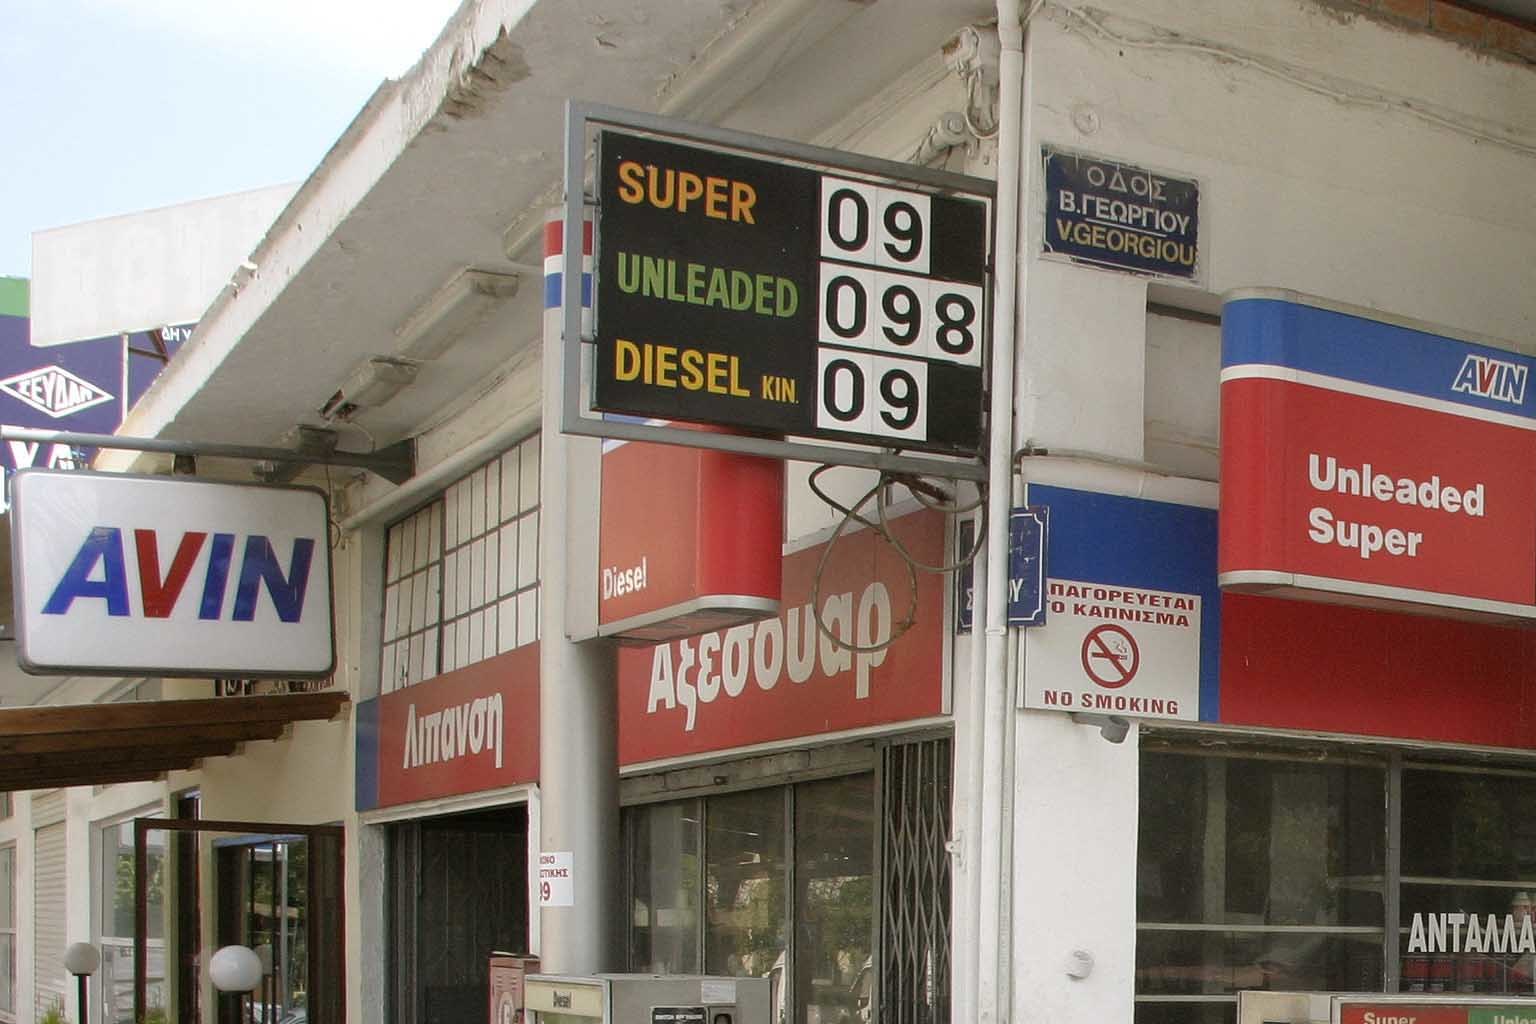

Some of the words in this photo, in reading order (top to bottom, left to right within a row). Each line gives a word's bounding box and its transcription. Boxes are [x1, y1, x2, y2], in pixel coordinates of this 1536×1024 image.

[618, 160, 758, 225] SUPER
[1087, 166, 1167, 200] ΟΔΟΣ
[827, 188, 923, 262] 09
[1059, 190, 1190, 235] Β.ΓΕΩΡΓΙΟΥ
[1056, 218, 1195, 267] V.GEORGIOU
[617, 252, 797, 318] UNLEADED
[824, 275, 976, 355] 098
[615, 339, 751, 398] DIESEL
[823, 357, 920, 431] 09
[1452, 353, 1528, 405] AVIN
[1307, 453, 1486, 519] Unleaded
[1308, 508, 1422, 559] Super
[40, 526, 315, 624] AVIN
[602, 557, 648, 602] Diesel
[1046, 583, 1195, 611] ΠΑΓΟΡΕΥΕΤΑΙ
[1074, 604, 1190, 627] ΚΑΠΝΙΣΜΑ
[647, 582, 892, 731] Αξεσουαρ
[1044, 690, 1073, 706] NO
[1082, 693, 1179, 715] SMOKING
